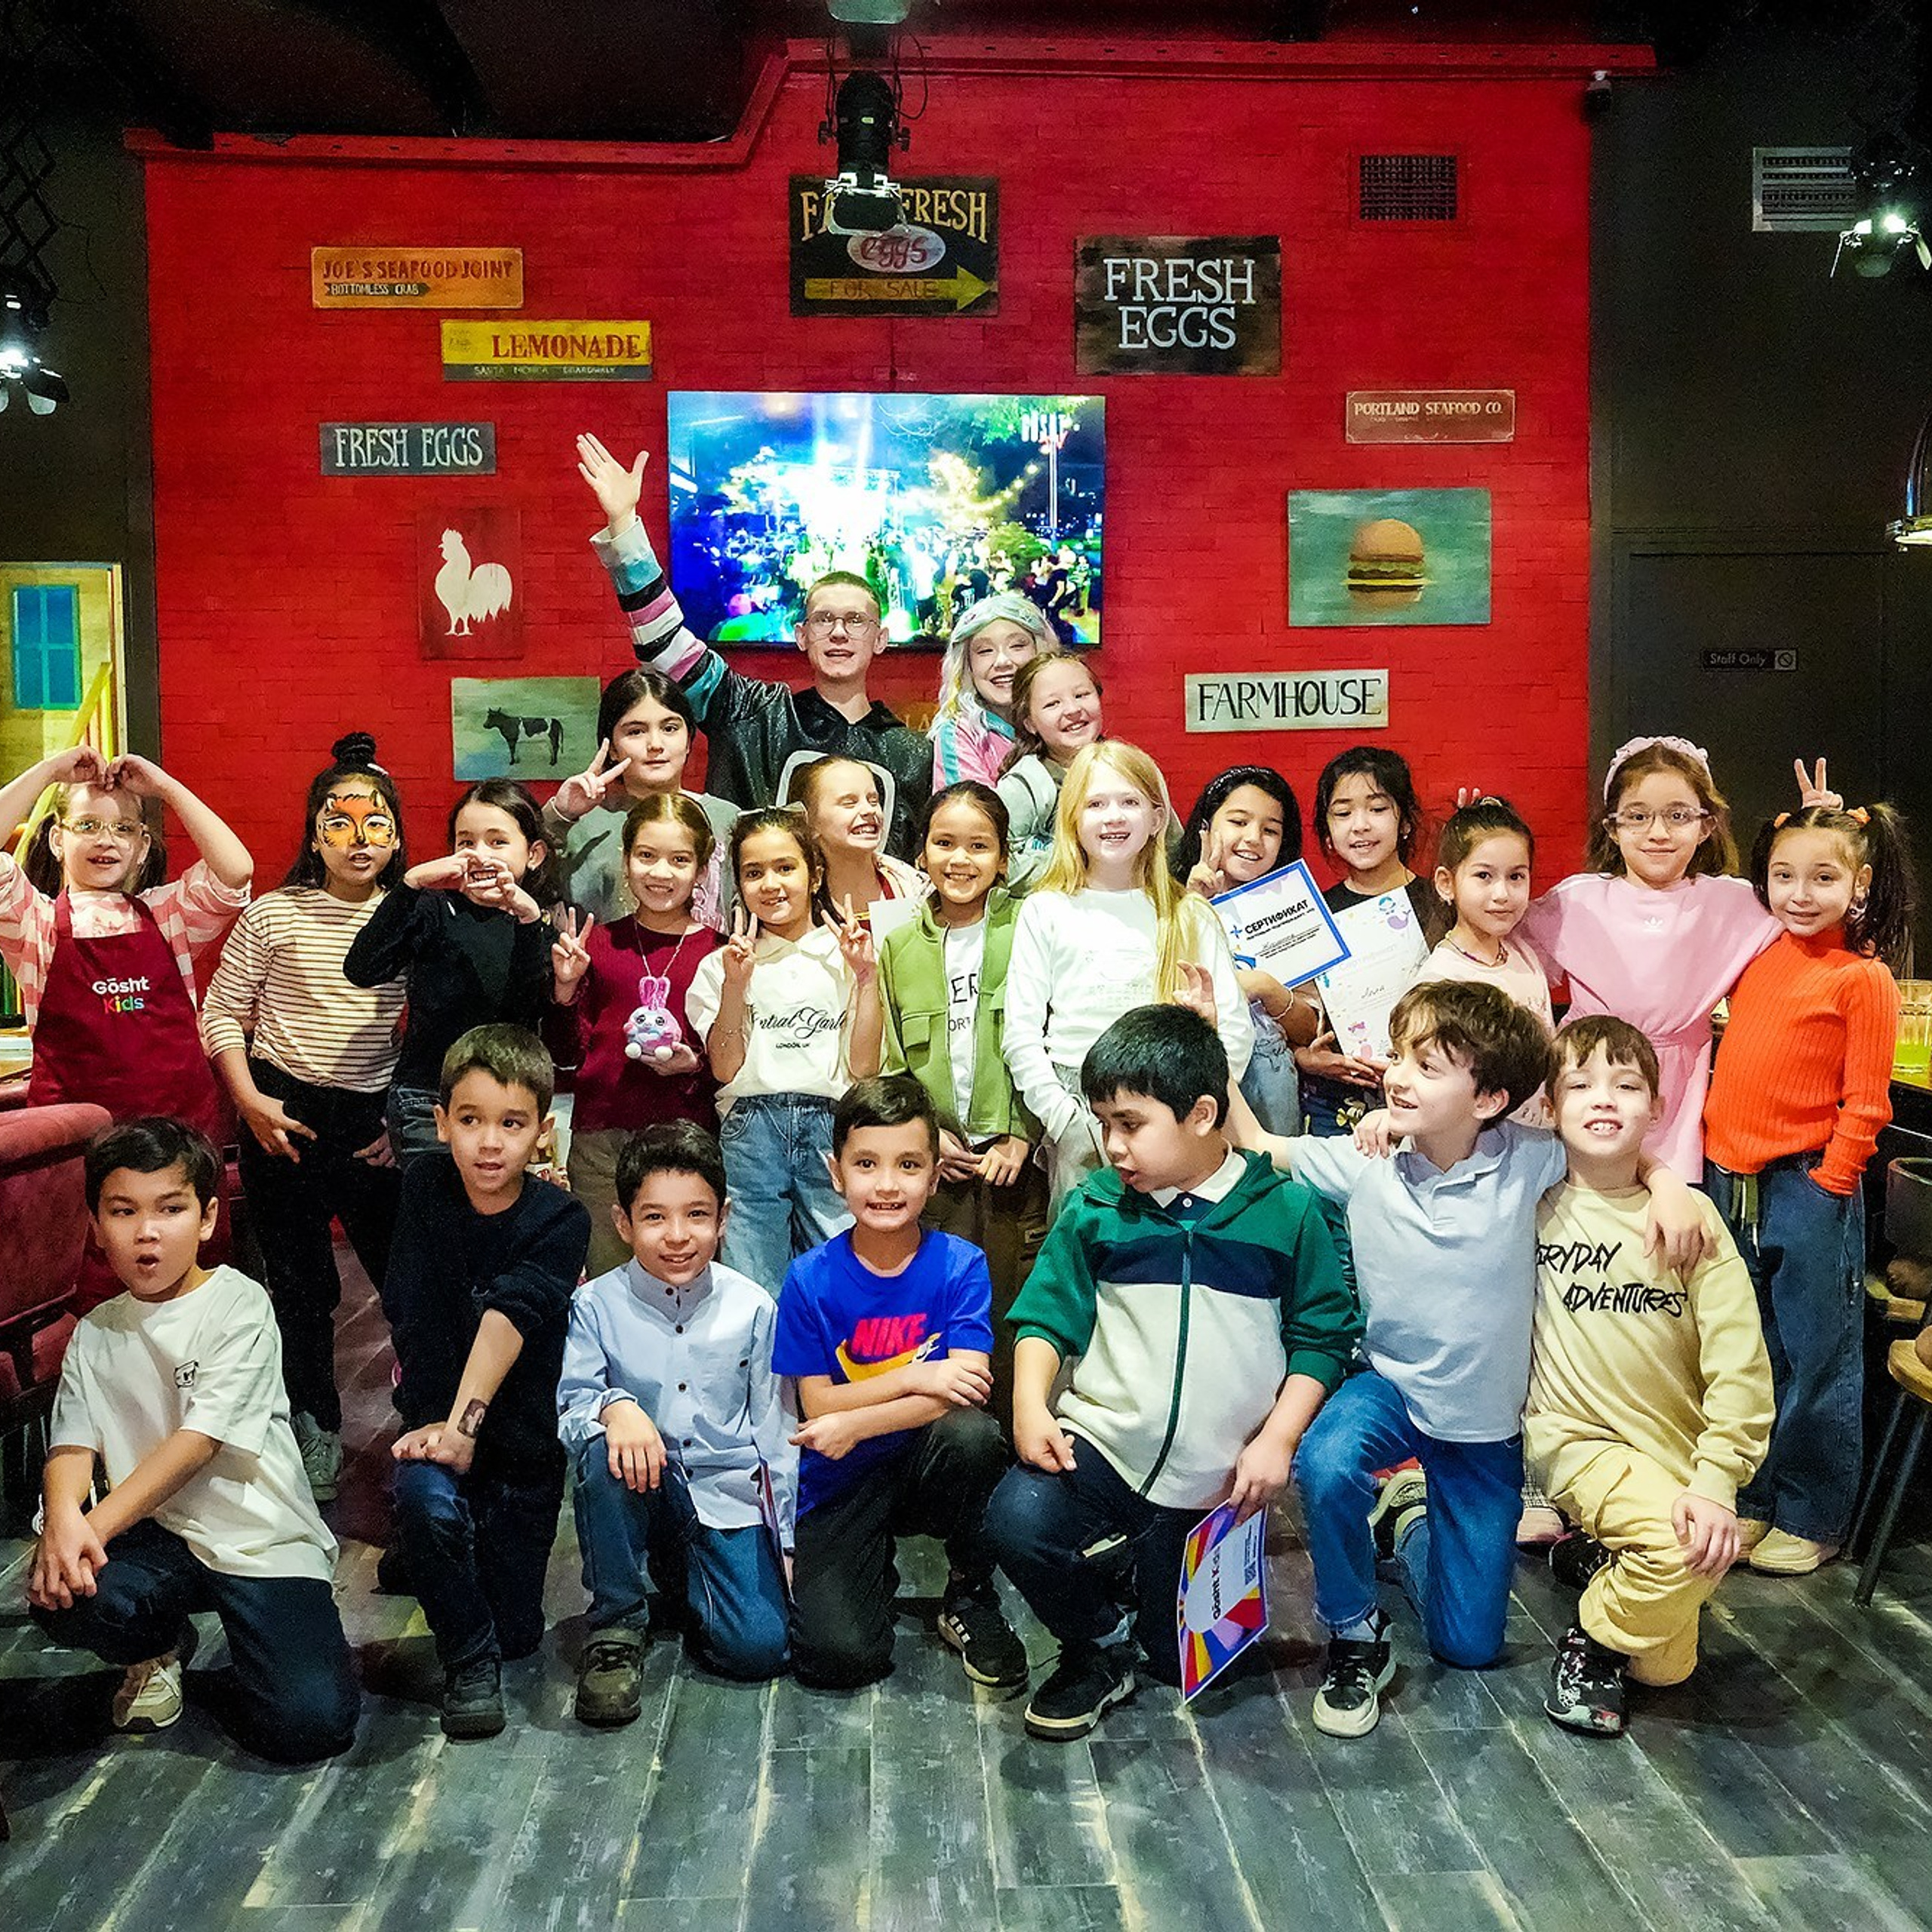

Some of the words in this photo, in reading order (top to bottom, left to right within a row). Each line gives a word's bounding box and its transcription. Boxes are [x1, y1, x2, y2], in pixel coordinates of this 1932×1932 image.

[900, 189, 988, 243] FRESH
[860, 232, 929, 269] eggs
[322, 260, 373, 279] JOE'S
[377, 260, 458, 279] SEAFOOD
[460, 260, 513, 278] JOINT
[1103, 257, 1257, 305] FRESH
[331, 283, 389, 295] BOTTOMLESS
[394, 283, 420, 295] CRAB
[830, 281, 872, 298] FOR
[886, 281, 939, 298] SALE
[1118, 306, 1237, 350] EGGS
[492, 334, 641, 359] LEMONADE
[1354, 401, 1420, 416] PORTLAND
[1425, 401, 1481, 415] SEAFOOD
[334, 428, 410, 467] FRESH
[421, 426, 484, 467] EGGS
[1709, 652, 1736, 664] Staff
[1738, 652, 1766, 667] Only
[1198, 678, 1382, 721] FARMHOUSE
[1244, 899, 1309, 934] СЕРТИФИКАТ
[103, 995, 145, 1014] Kids
[1562, 1281, 1688, 1318] ADVENTURES
[851, 1313, 928, 1357] NIKE
